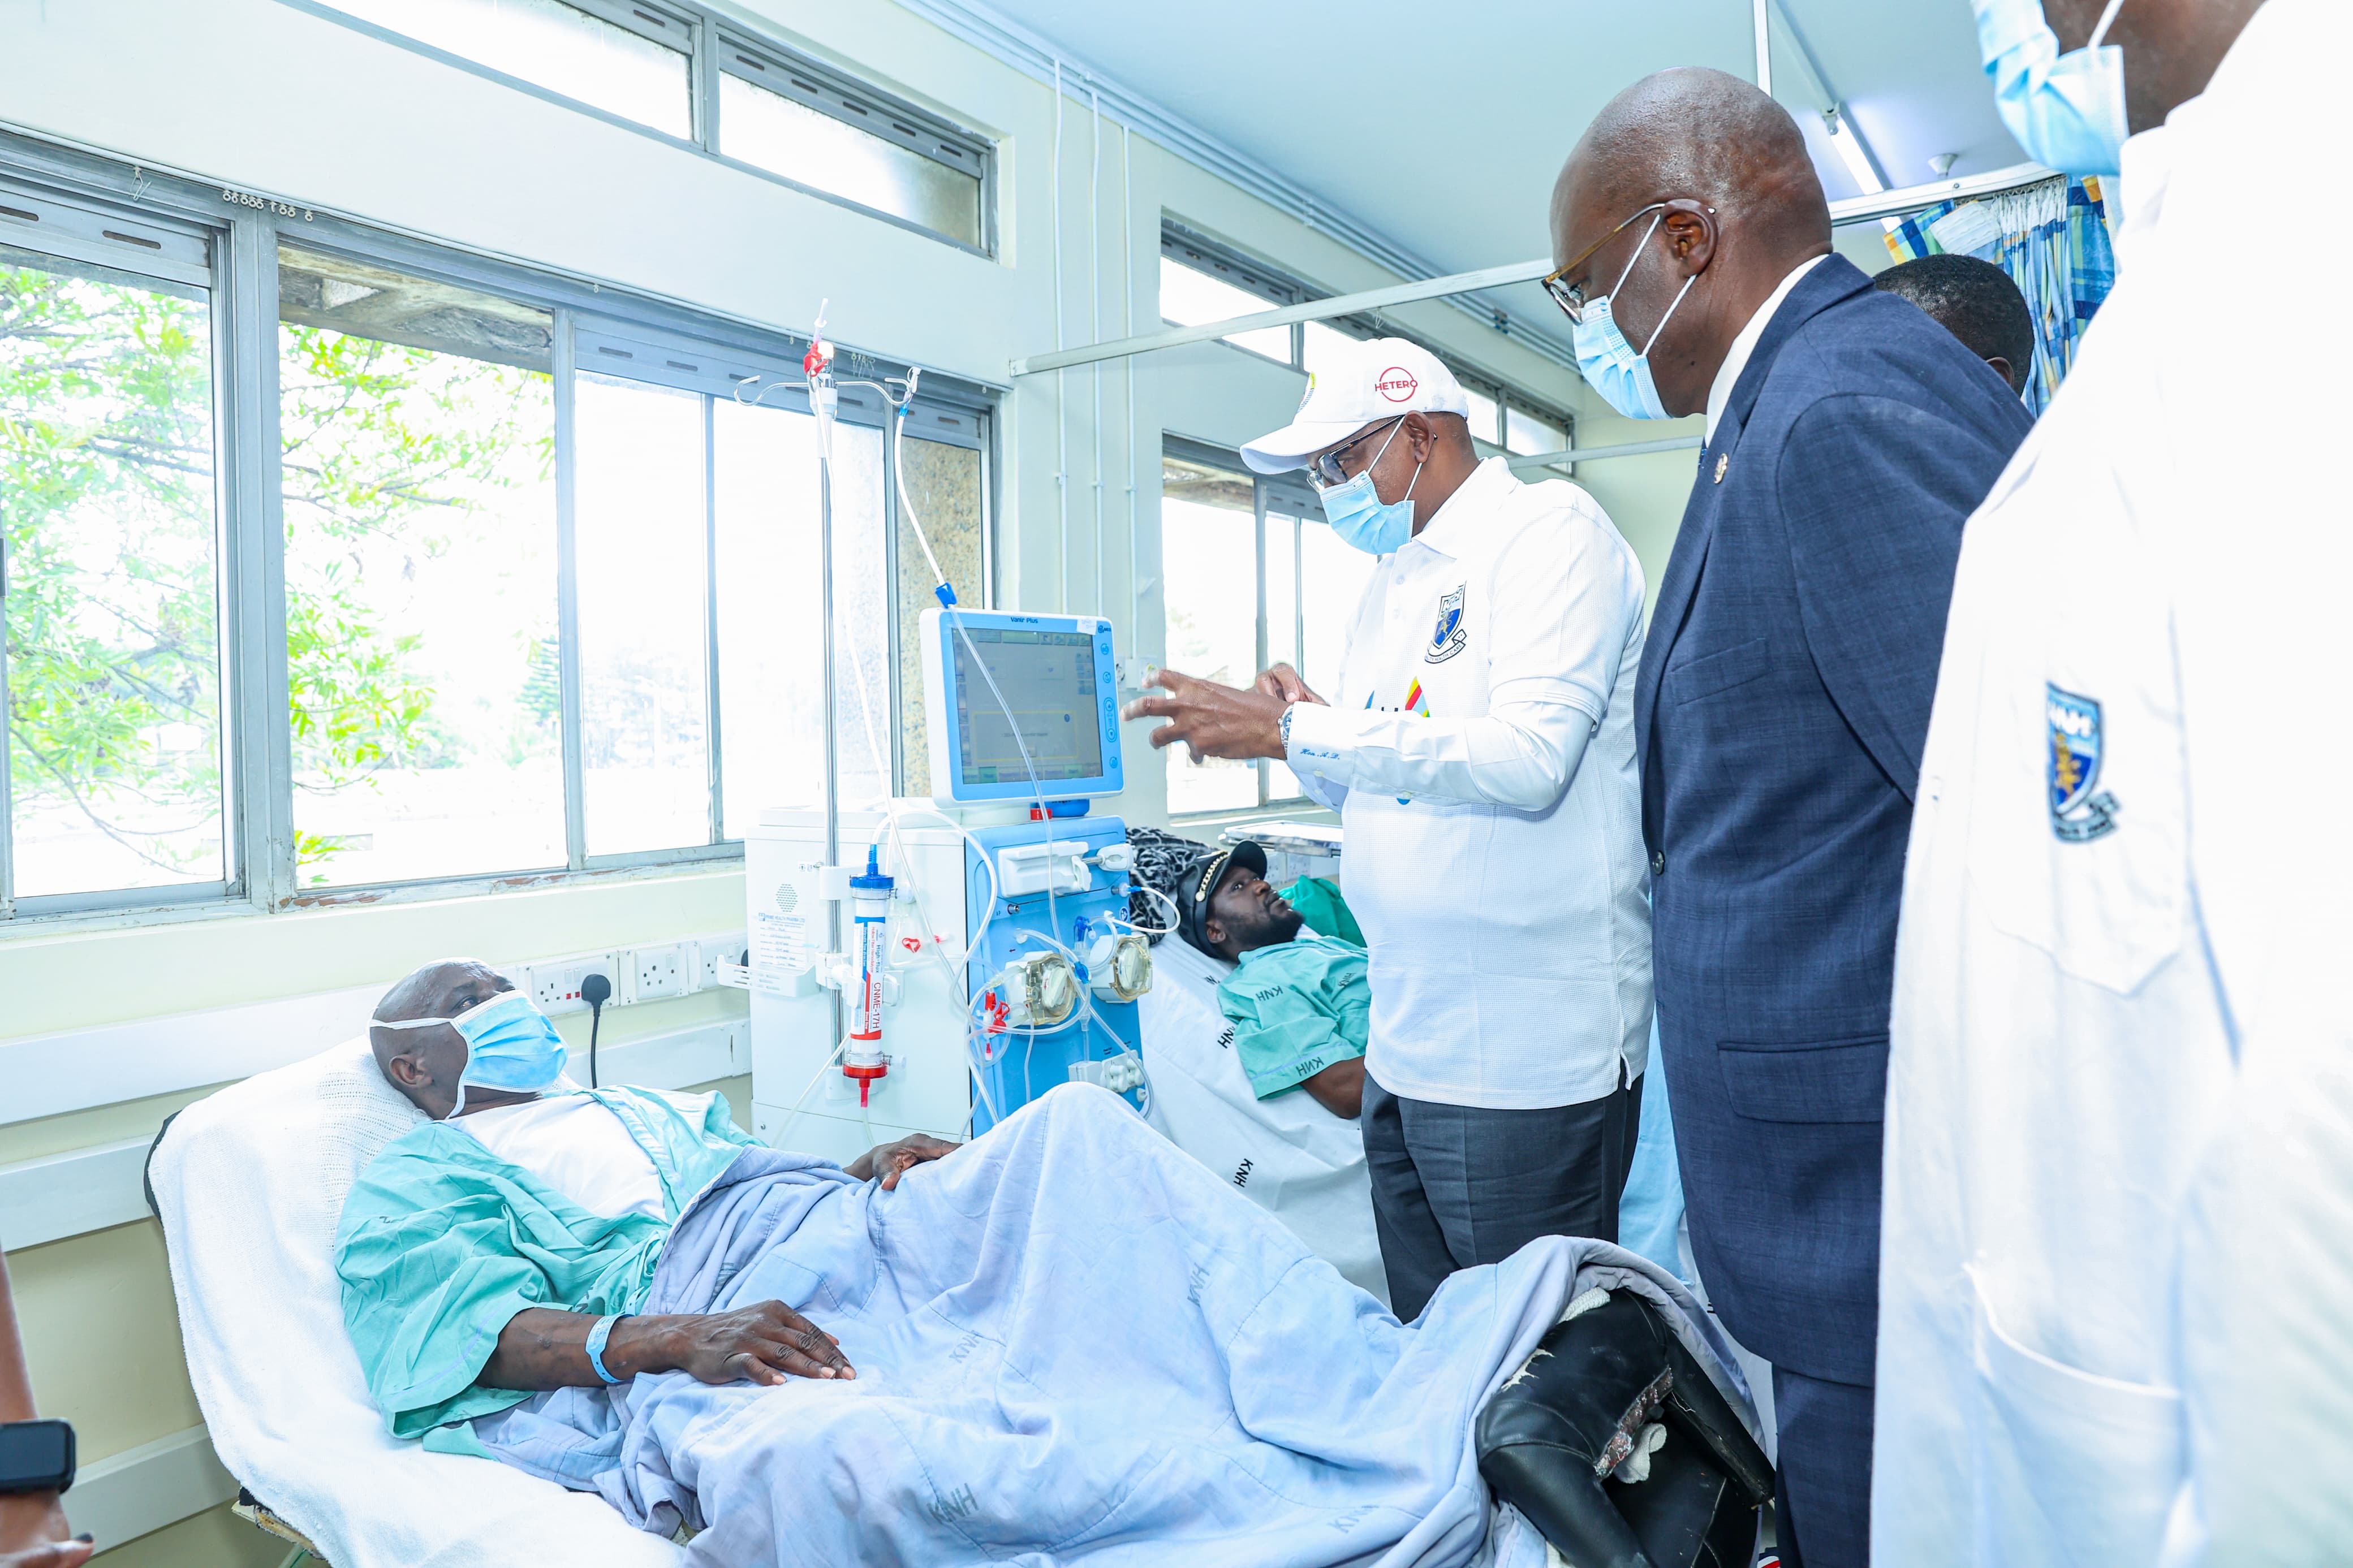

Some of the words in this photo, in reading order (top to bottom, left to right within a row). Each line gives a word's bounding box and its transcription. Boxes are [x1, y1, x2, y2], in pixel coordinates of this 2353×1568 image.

[1374, 379, 1418, 392] HETERO
[1450, 643, 1462, 655] CARE
[1255, 985, 1284, 1002] KNH
[872, 982, 881, 1029] CNME-17H
[1295, 1056, 1324, 1077] KNH
[1233, 1158, 1253, 1188] KNH
[926, 1482, 979, 1525] KNH
